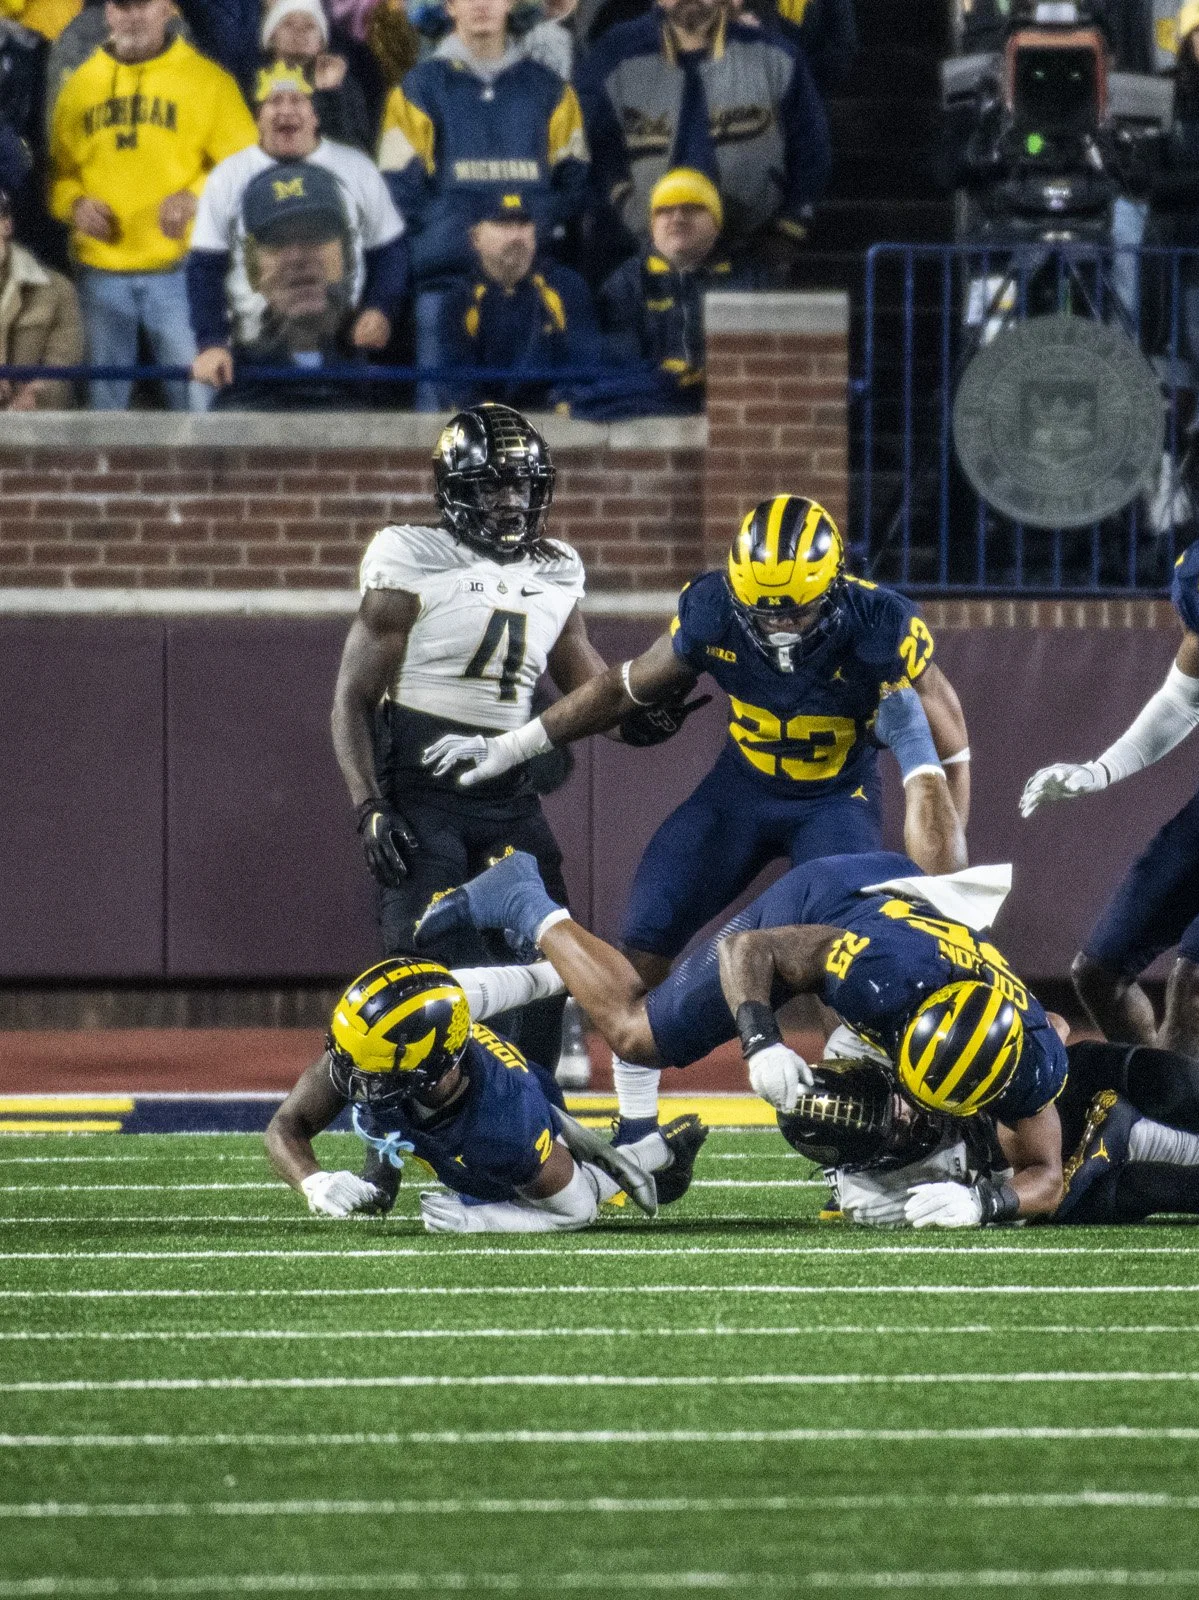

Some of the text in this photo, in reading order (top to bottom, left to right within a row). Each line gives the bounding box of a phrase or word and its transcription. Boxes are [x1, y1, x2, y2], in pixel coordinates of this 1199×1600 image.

[272, 177, 305, 201] M
[768, 597, 781, 606] M
[462, 607, 528, 703] 4
[899, 617, 934, 680] 23
[729, 694, 857, 781] 23
[825, 931, 871, 980] 25
